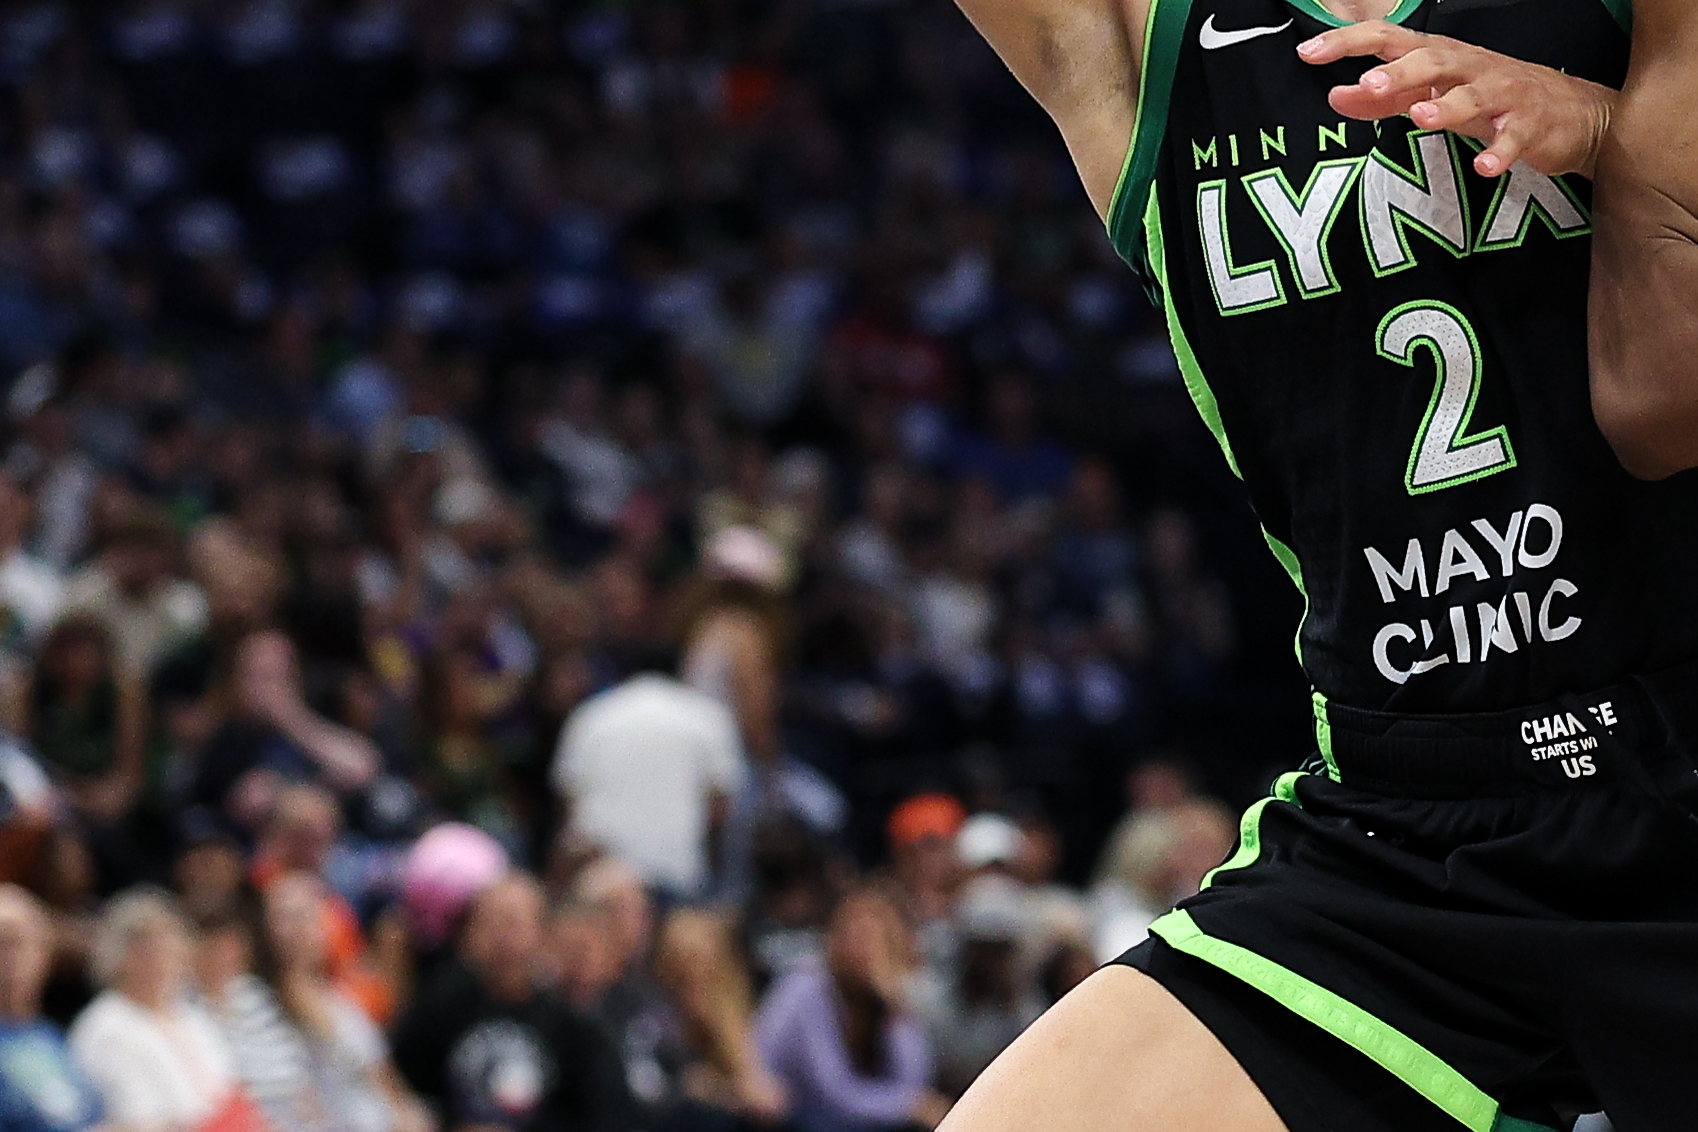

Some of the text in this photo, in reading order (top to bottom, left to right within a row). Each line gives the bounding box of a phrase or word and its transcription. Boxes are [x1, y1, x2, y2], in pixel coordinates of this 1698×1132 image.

[1191, 118, 1381, 171] MINN
[1196, 128, 1593, 318] LYNX
[1375, 299, 1518, 496] 2
[1362, 502, 1564, 604] MAYO
[1372, 577, 1583, 685] CLINIC
[1530, 740, 1580, 761] STARTS
[1560, 754, 1597, 779] US
